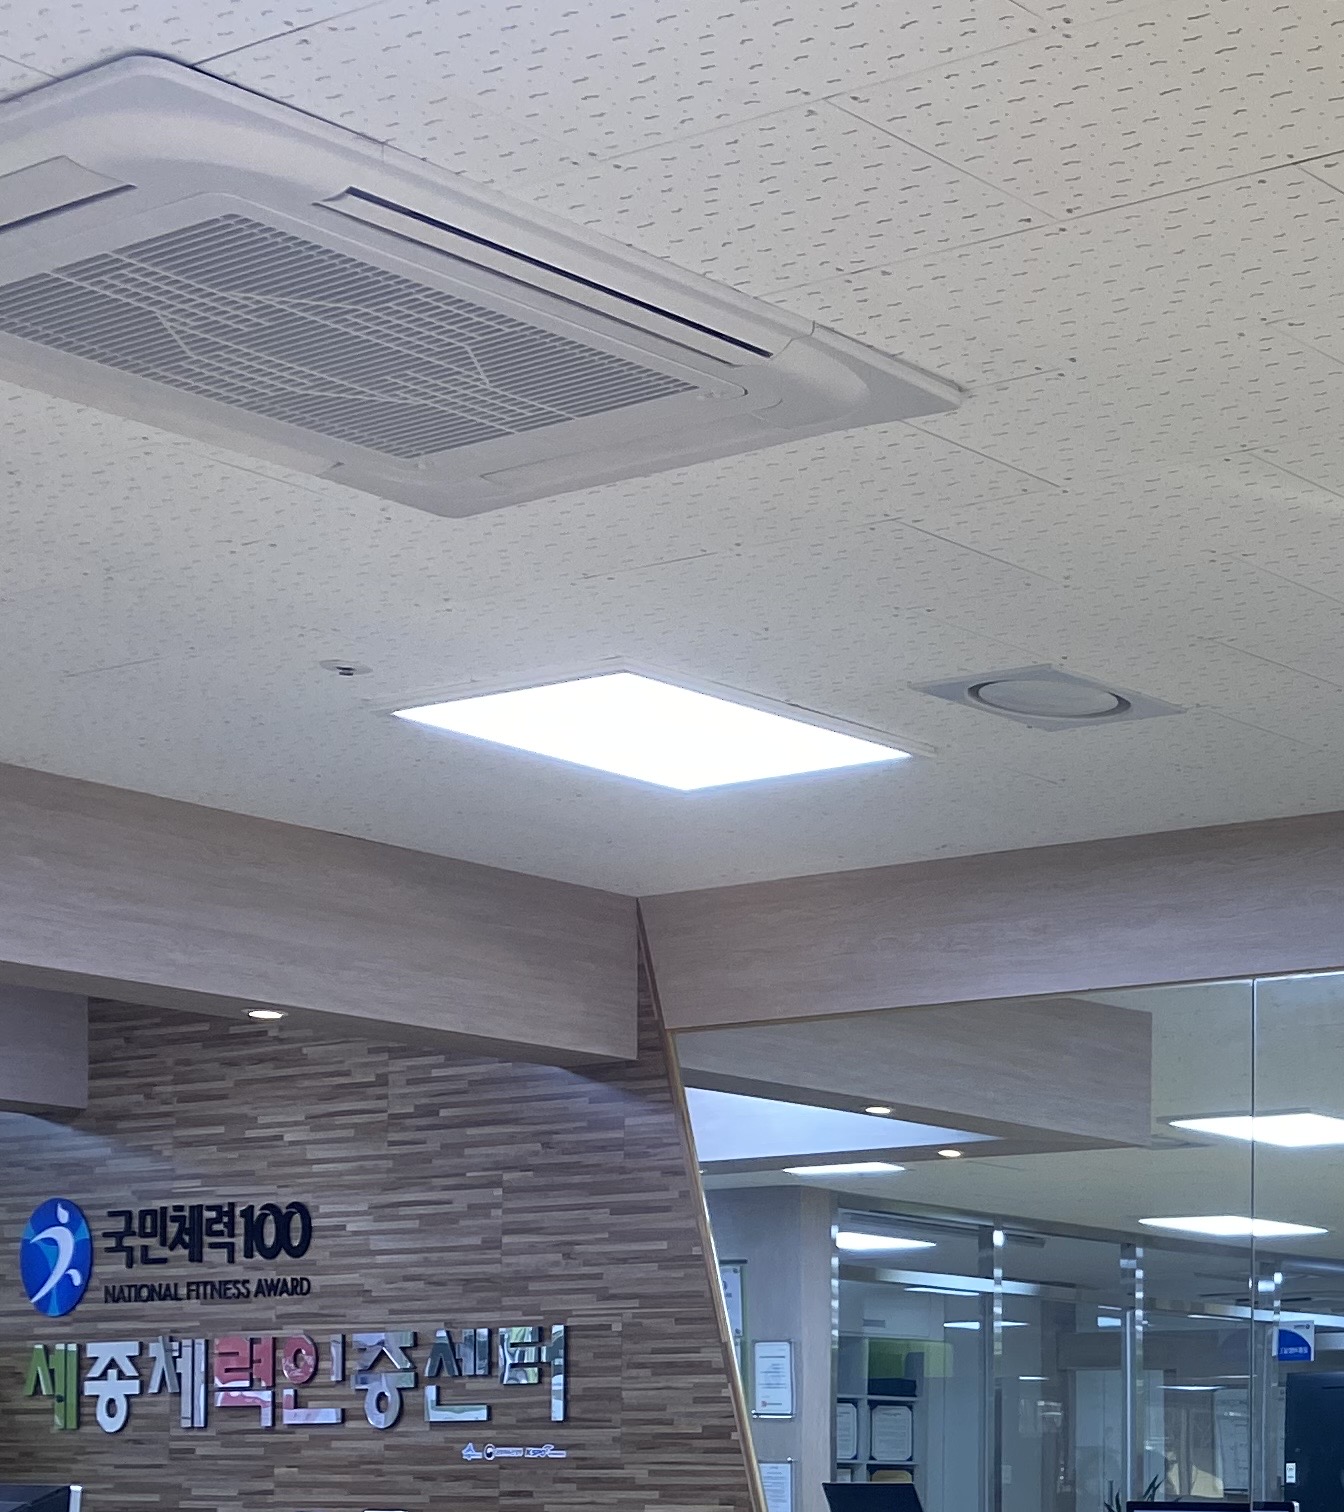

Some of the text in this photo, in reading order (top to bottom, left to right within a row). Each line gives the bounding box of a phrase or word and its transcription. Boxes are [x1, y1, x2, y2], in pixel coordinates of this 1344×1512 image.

[101, 1201, 313, 1269] 국민체력100
[104, 1276, 311, 1304] NATIONAL FITNESS AWARD
[23, 1323, 567, 1434] 세종체력인증센터
